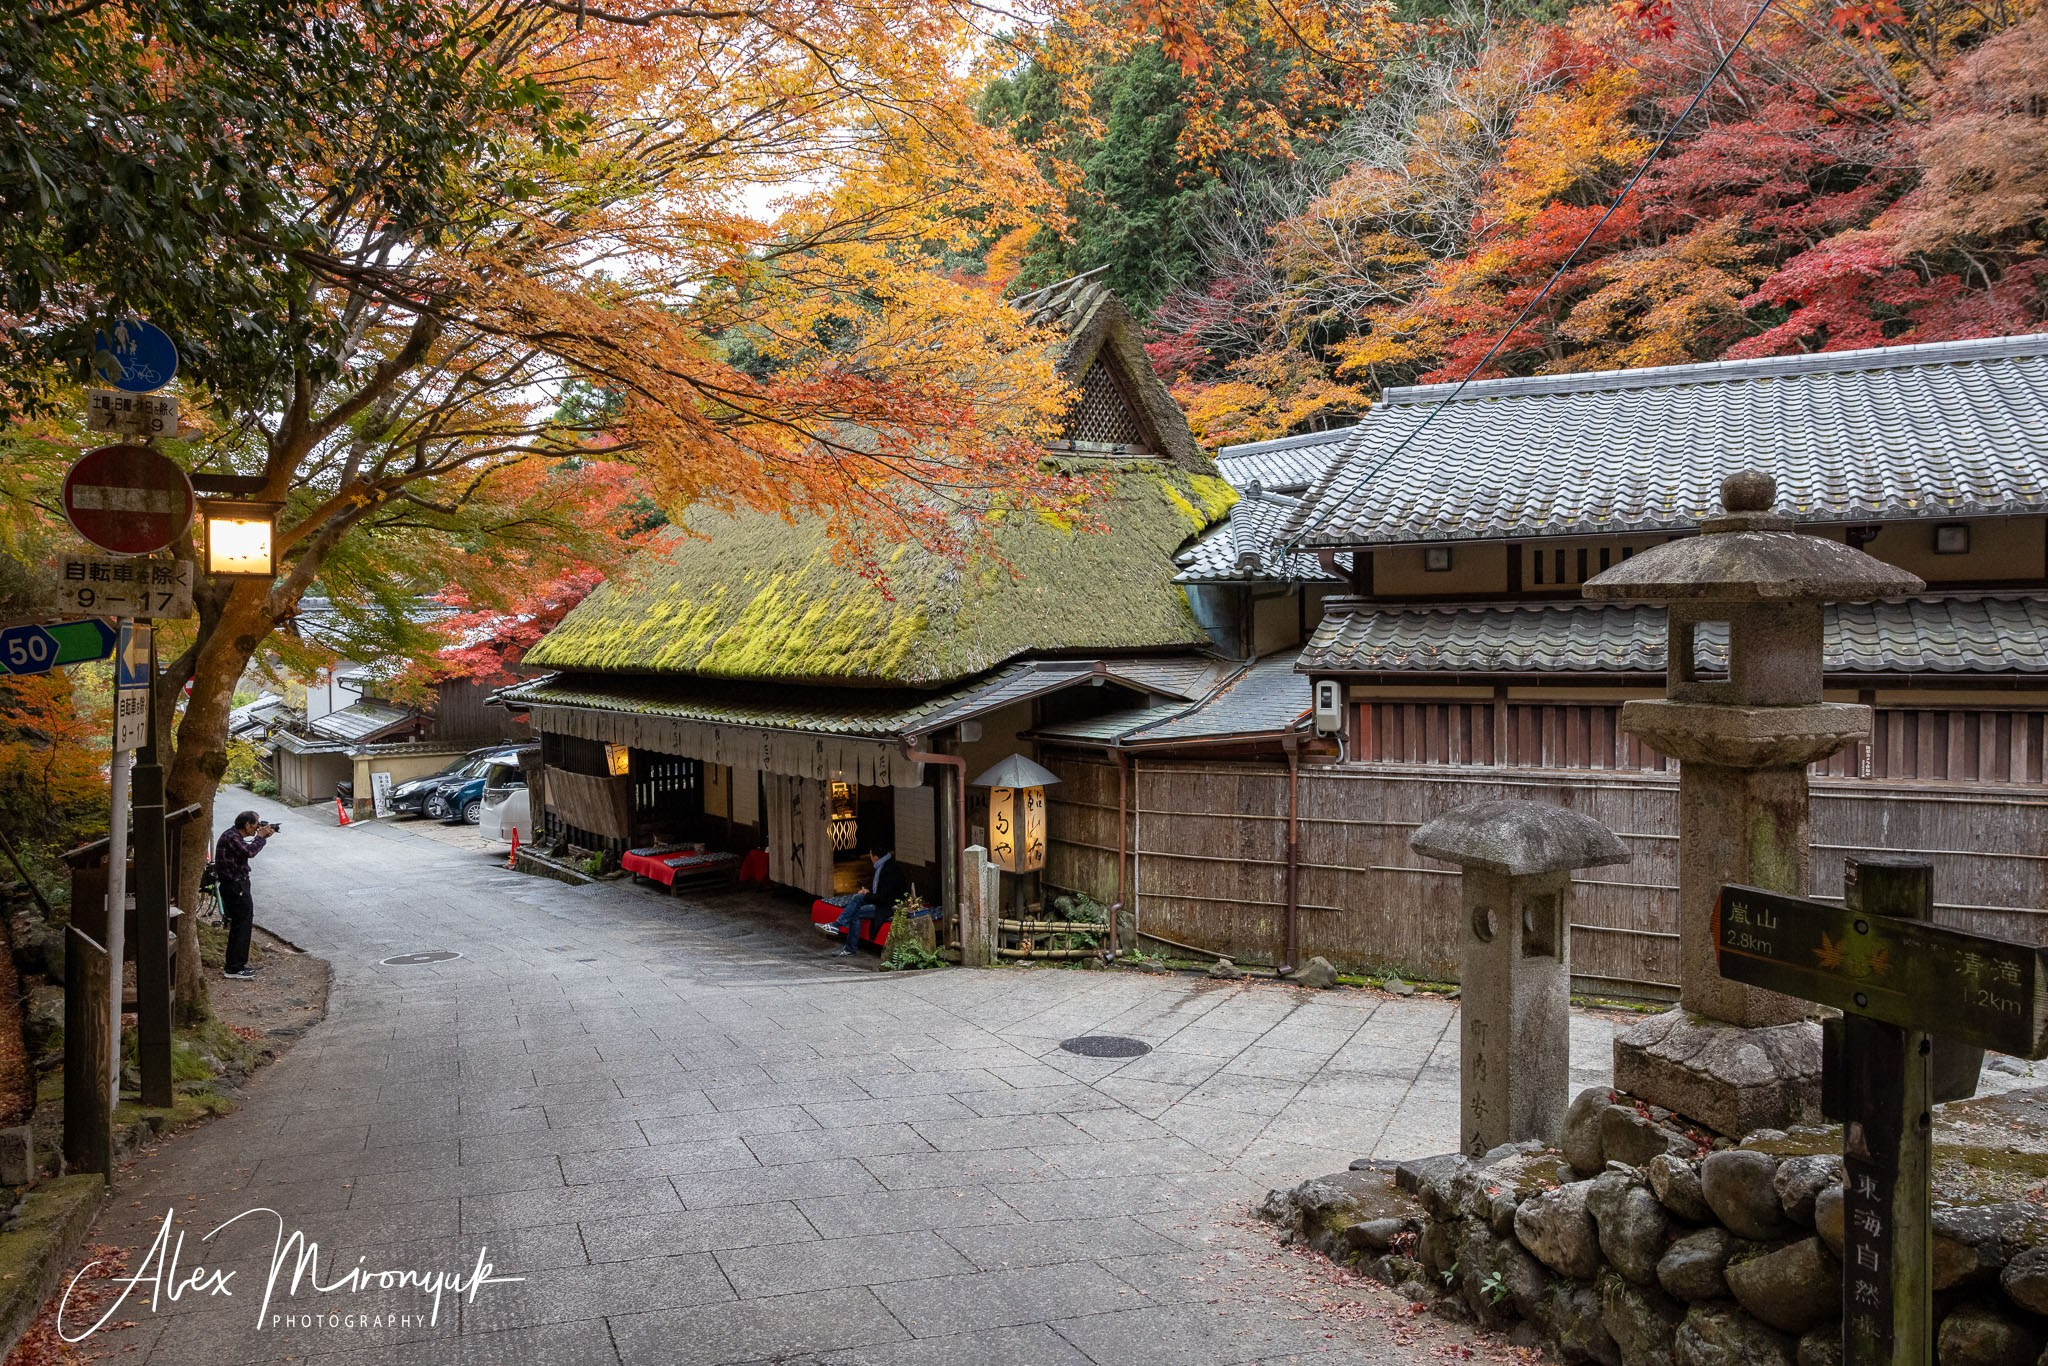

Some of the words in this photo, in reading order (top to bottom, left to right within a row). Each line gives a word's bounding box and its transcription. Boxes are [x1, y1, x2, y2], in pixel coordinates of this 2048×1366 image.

[65, 562, 187, 587] 自転車を除く
[8, 635, 47, 665] 50
[1727, 899, 1777, 929] 嵐山
[1727, 930, 1772, 954] 2.8km
